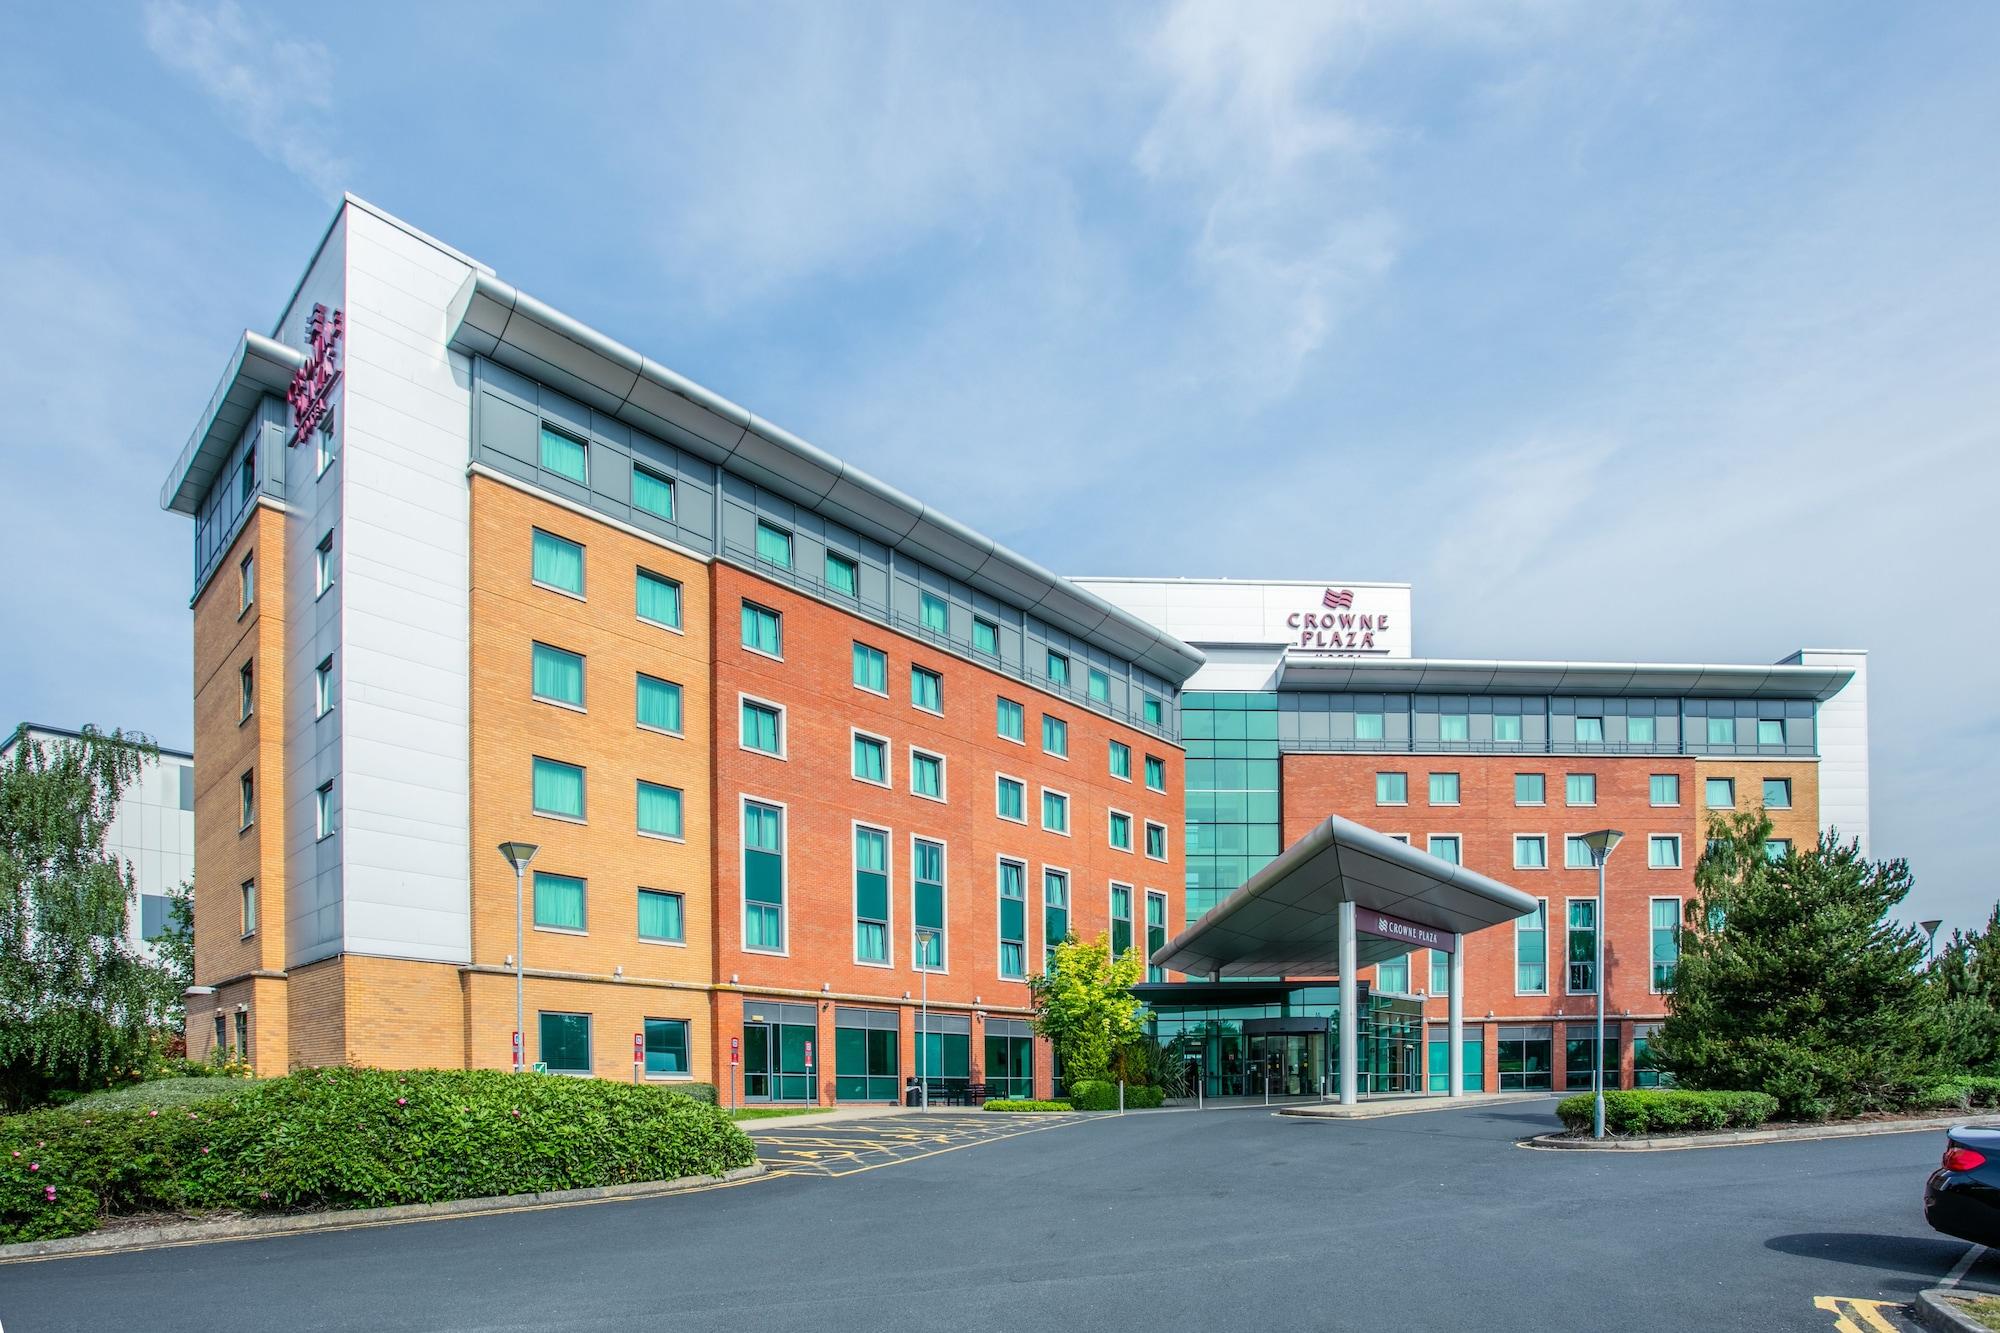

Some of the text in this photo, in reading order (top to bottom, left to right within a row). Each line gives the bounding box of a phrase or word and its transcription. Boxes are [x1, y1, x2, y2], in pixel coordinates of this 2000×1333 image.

[1287, 612, 1389, 630] CROWNE
[1301, 630, 1374, 647] PLAZA
[1389, 922, 1437, 943] CROWNE PLAZA
